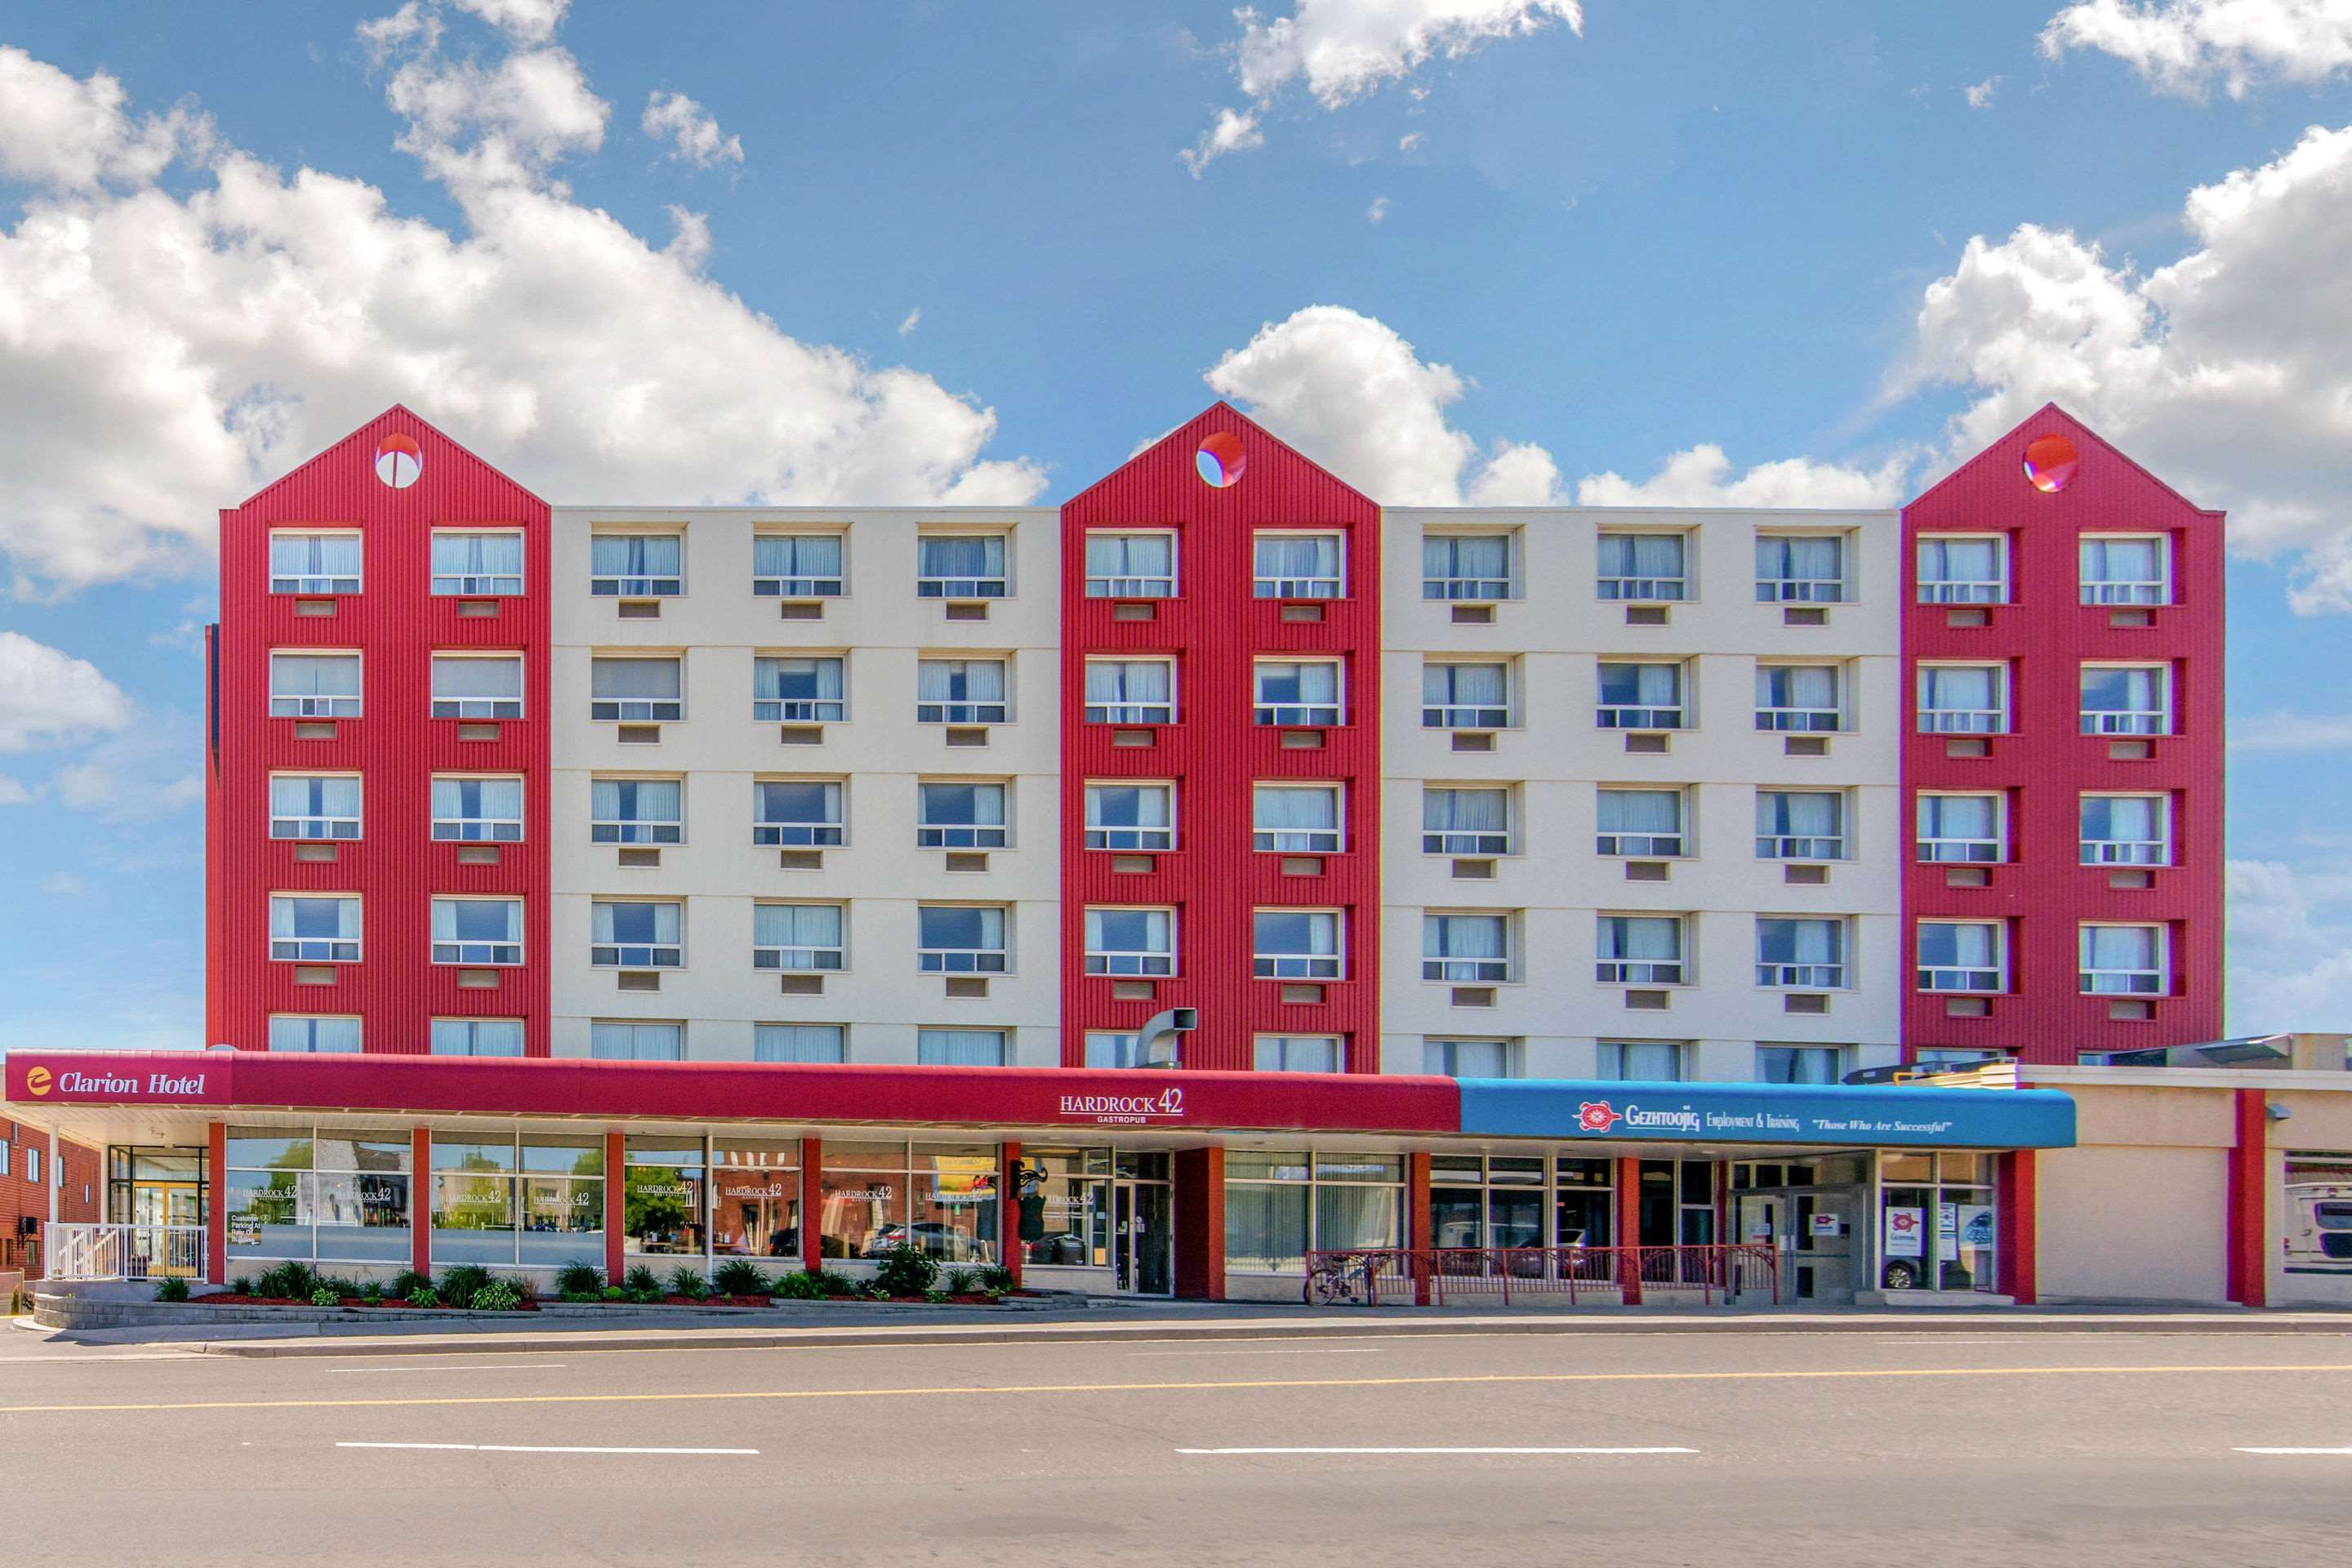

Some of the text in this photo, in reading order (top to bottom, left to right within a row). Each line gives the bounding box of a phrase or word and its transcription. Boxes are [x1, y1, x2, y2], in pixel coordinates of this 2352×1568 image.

[59, 1071, 204, 1094] Clarion Hotel
[1060, 1088, 1184, 1113] HARDROCK 42
[1756, 1111, 1764, 1128] &
[1849, 1120, 1872, 1130] Who
[1873, 1121, 1891, 1131] Are
[284, 1185, 297, 1197] 42
[377, 1187, 391, 1200] 42
[637, 1181, 693, 1193] HARDROCK 42
[725, 1183, 782, 1196] HARDROCK 42
[835, 1186, 893, 1198] HARDROCK 42
[444, 1189, 501, 1203] HRDROCK 42
[576, 1192, 589, 1205] 42
